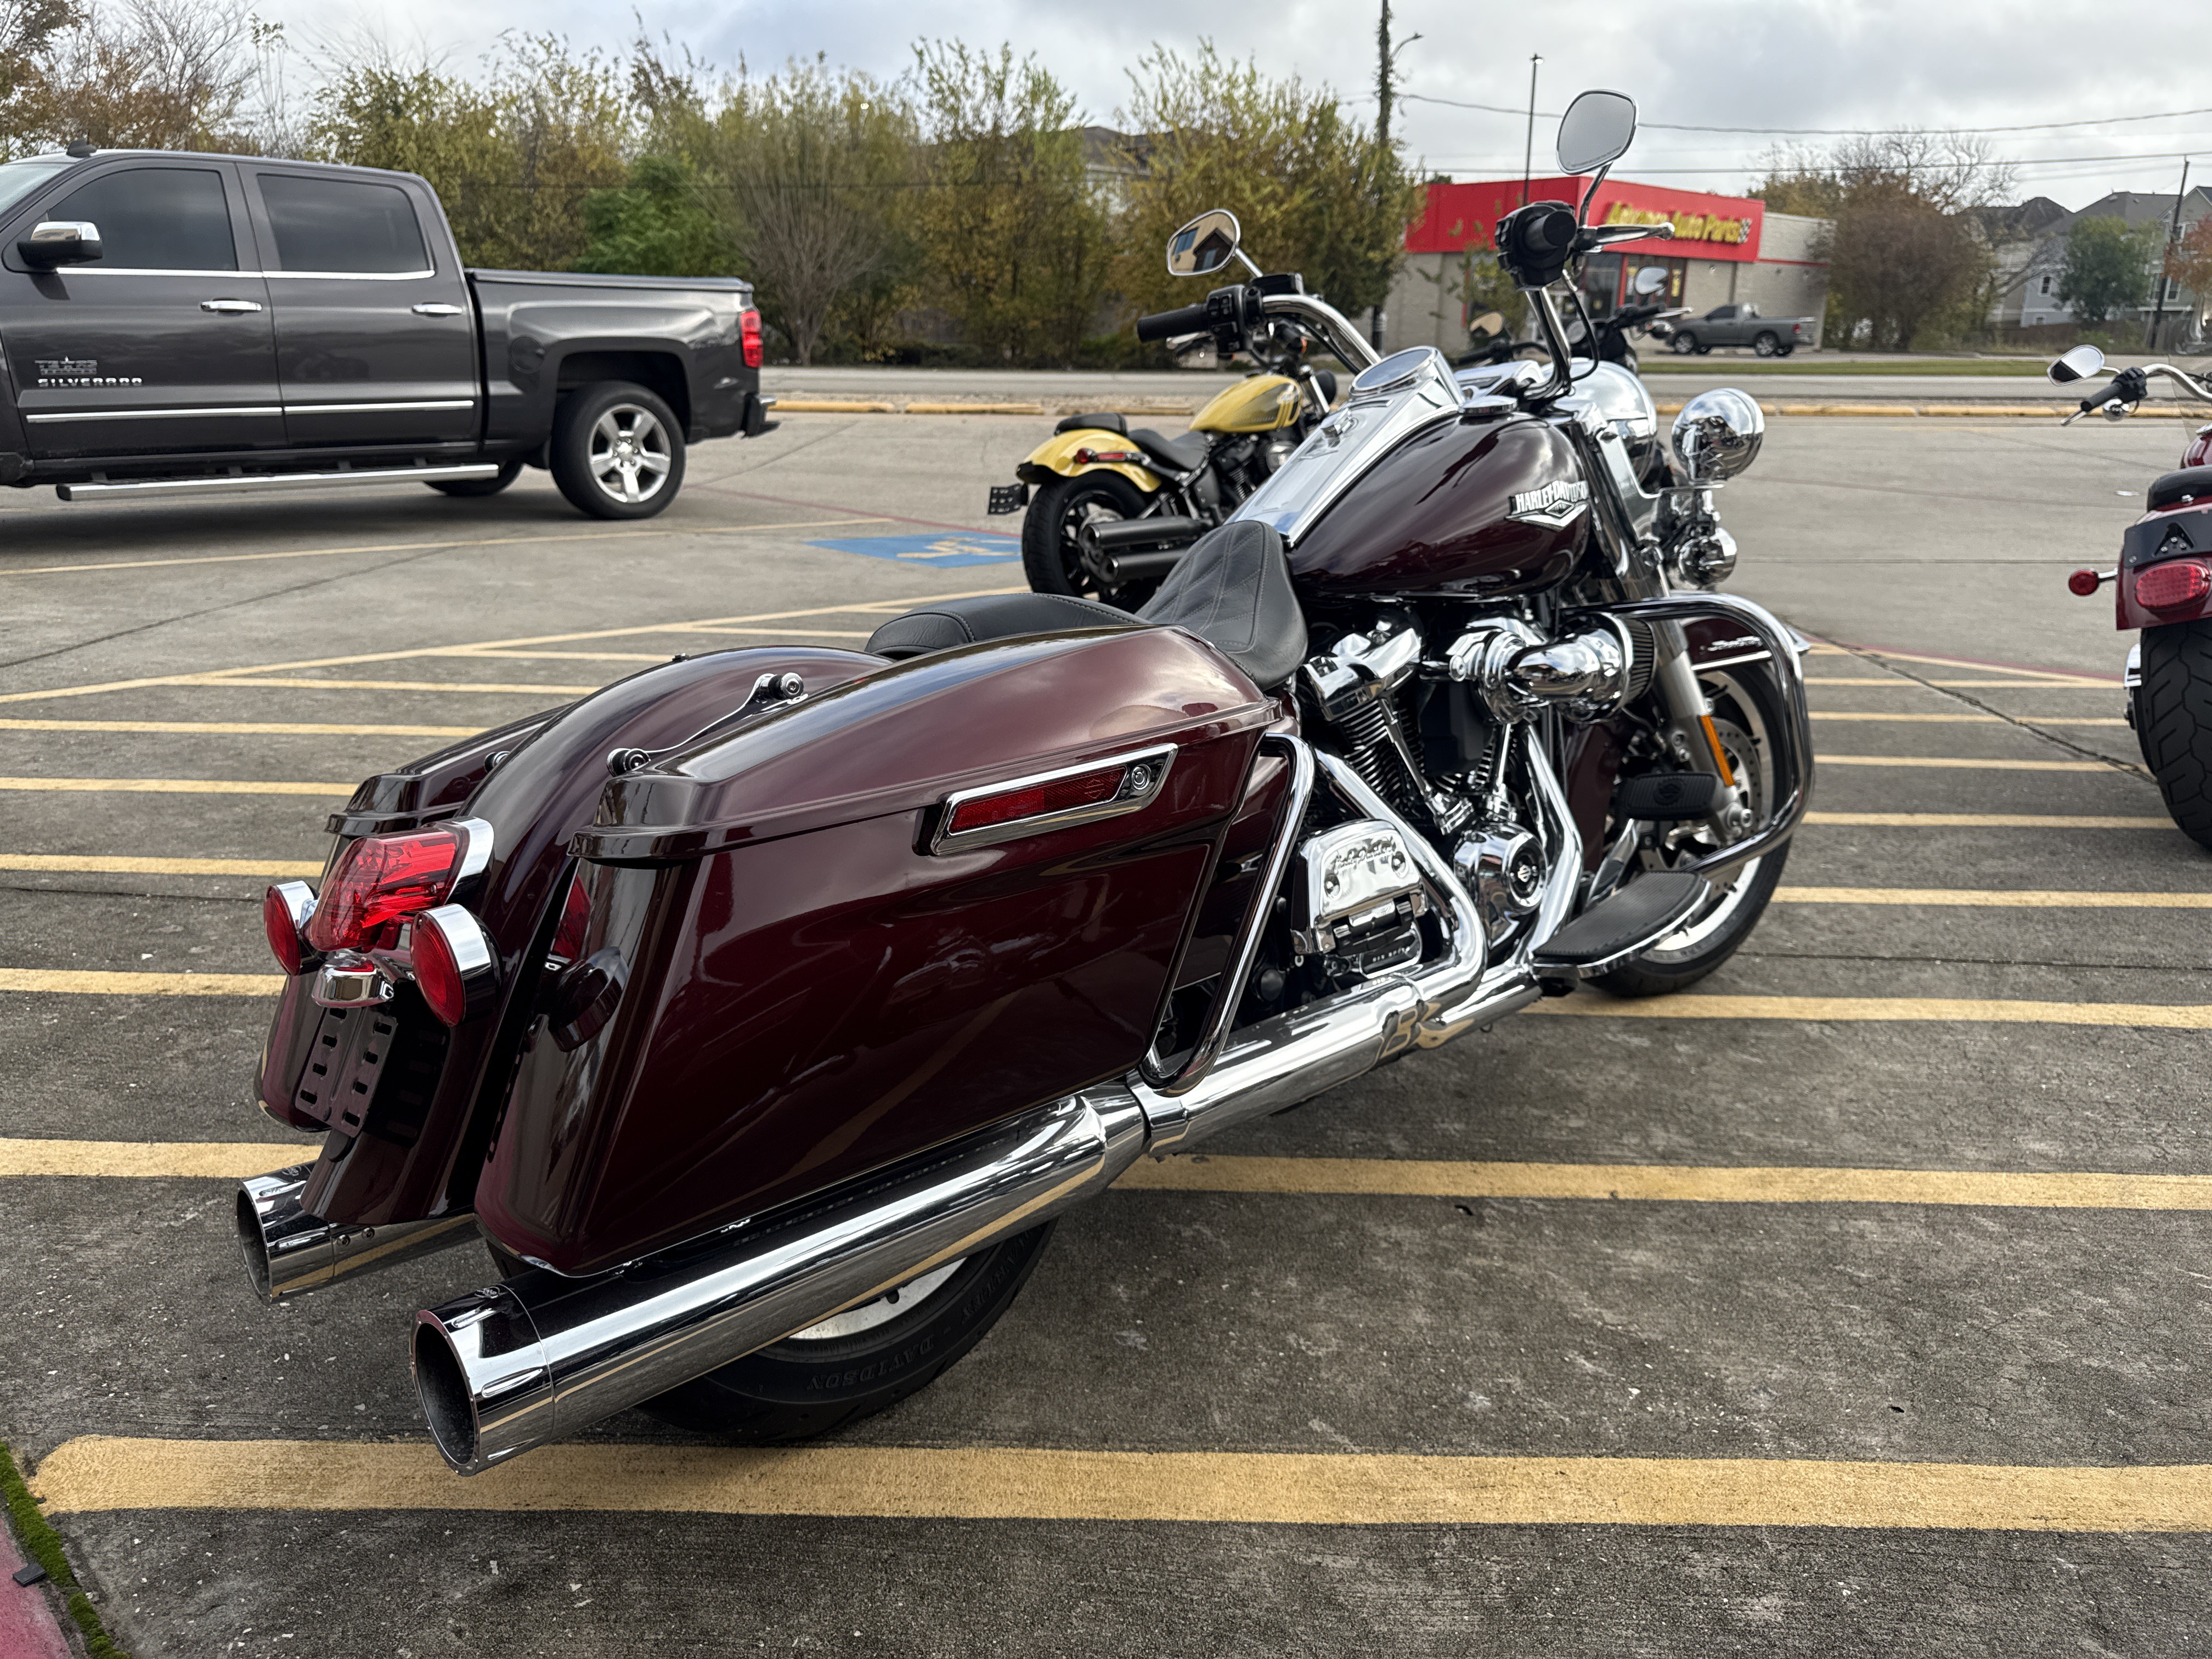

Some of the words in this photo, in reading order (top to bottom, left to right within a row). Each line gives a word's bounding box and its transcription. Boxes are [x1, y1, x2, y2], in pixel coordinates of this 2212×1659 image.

[1671, 210, 1703, 239] Auto
[1702, 214, 1741, 243] Parts
[37, 377, 143, 387] SILVERADO
[1511, 481, 1589, 515] HARLEY-DAVIDSO
[806, 1337, 935, 1391] DAVIDSON
